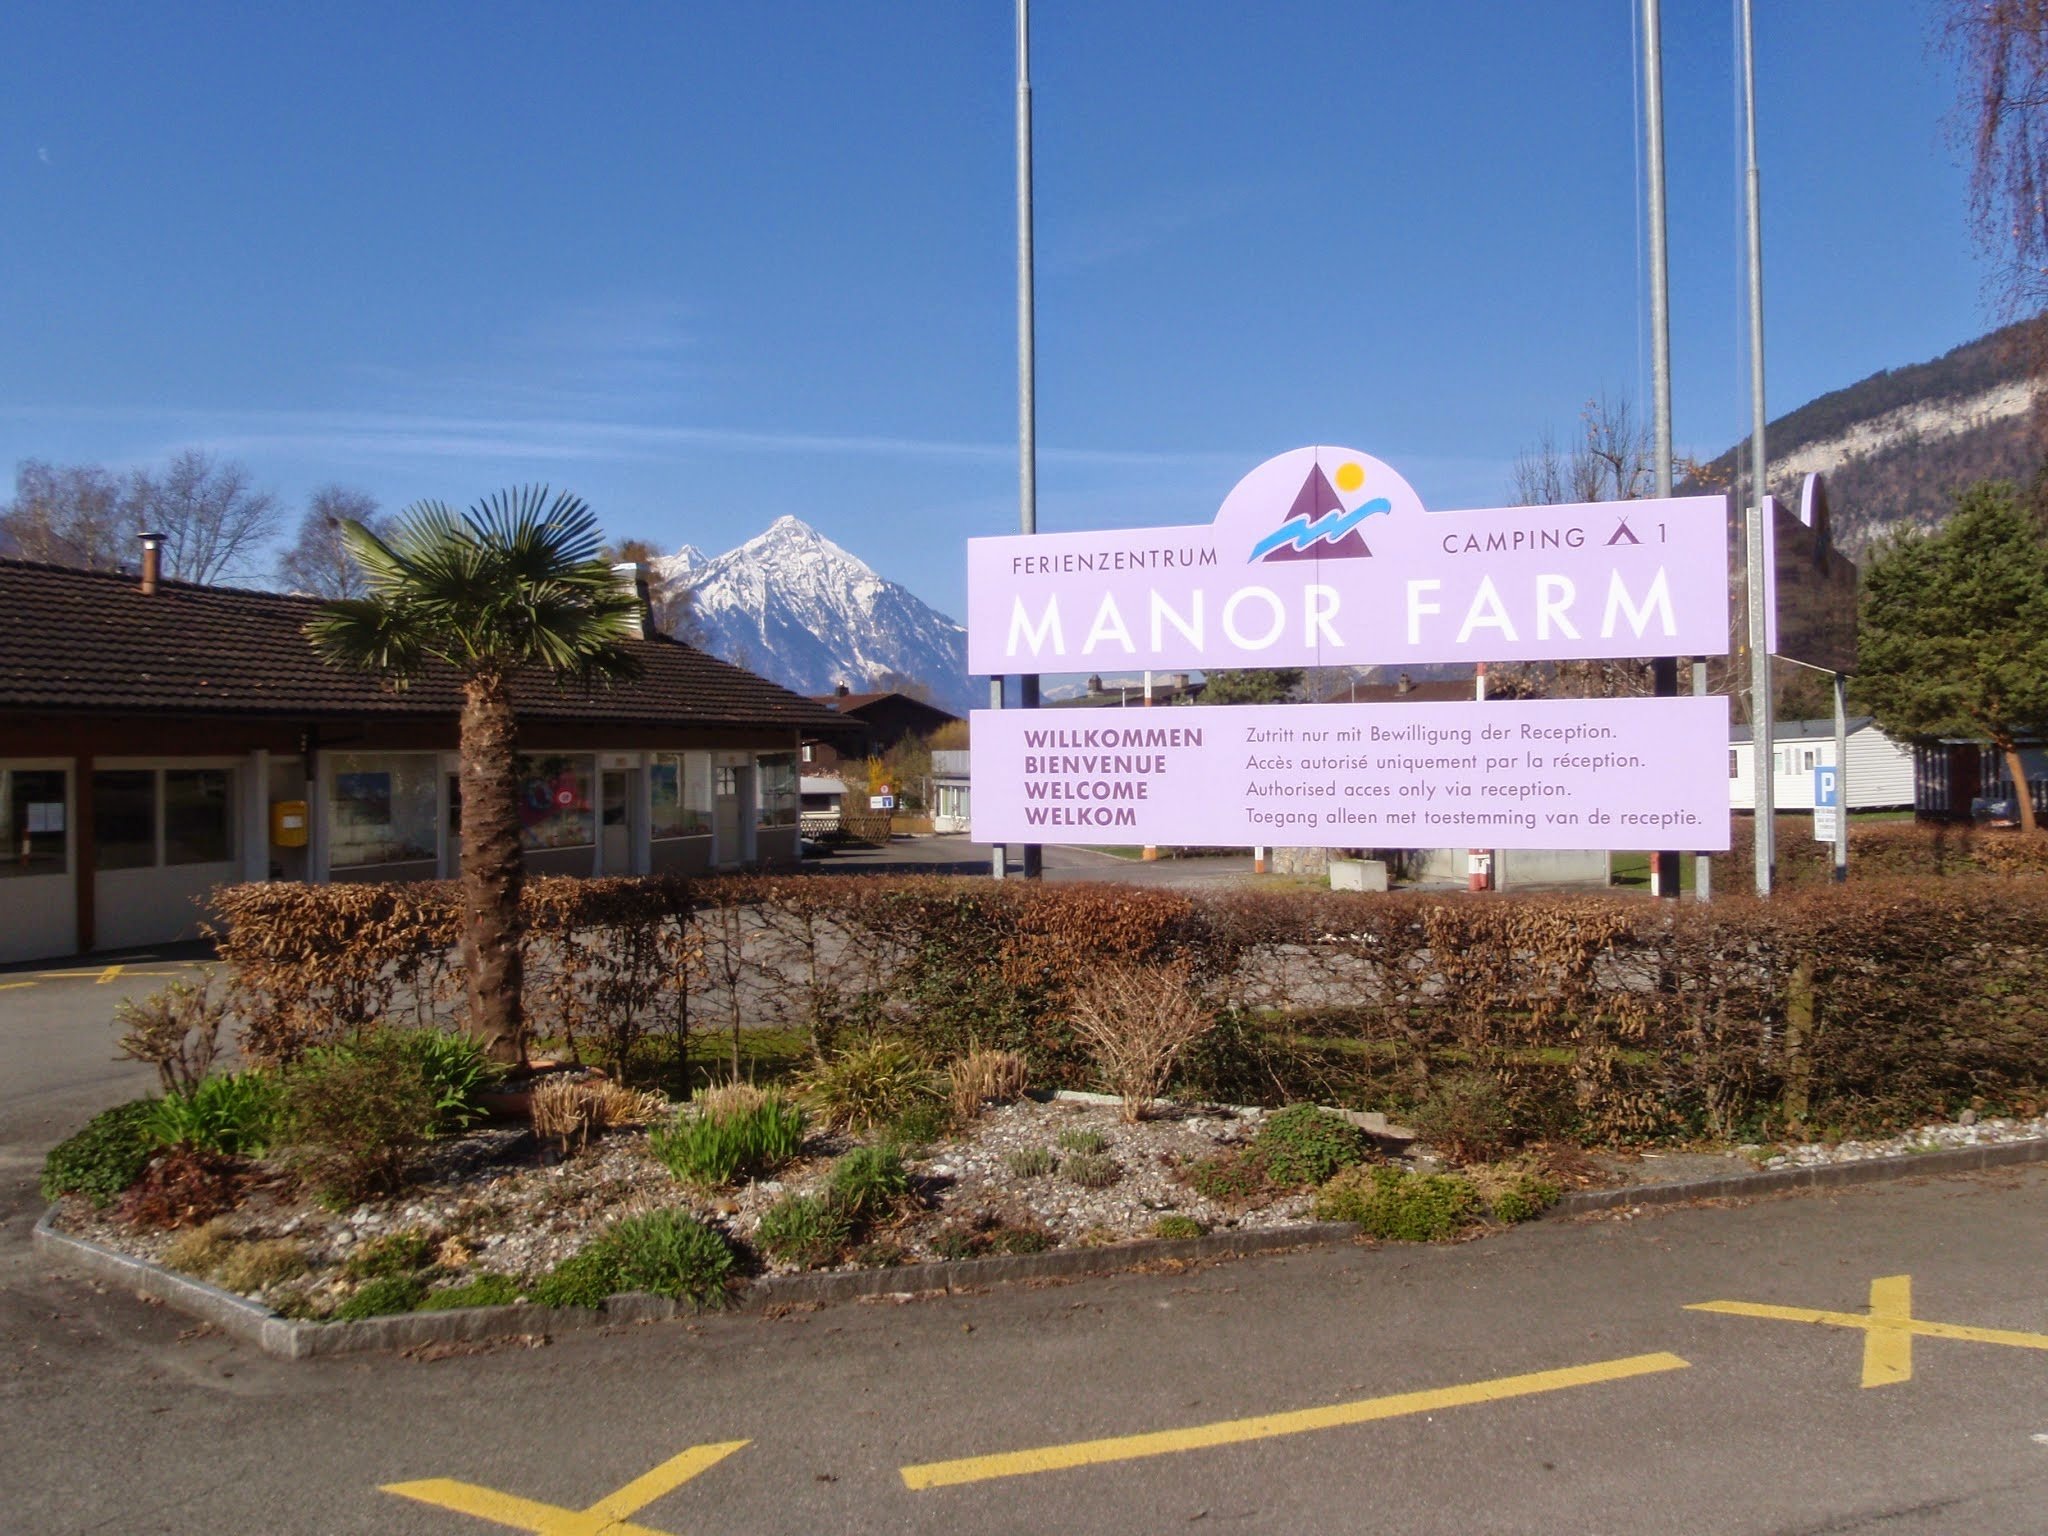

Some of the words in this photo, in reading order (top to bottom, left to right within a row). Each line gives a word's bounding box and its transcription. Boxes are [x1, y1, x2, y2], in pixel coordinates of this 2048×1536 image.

[1443, 528, 1584, 553] CAMPING
[1658, 524, 1665, 543] 1
[1013, 547, 1217, 574] FERIENZENTRUM
[1005, 583, 1345, 657] MANOR
[1406, 564, 1678, 645] FARM
[1024, 728, 1202, 748] WILLKOMMEN
[1246, 727, 1294, 742] Zutritt
[1303, 732, 1329, 742] nur
[1337, 727, 1361, 741] mit
[1371, 724, 1471, 745] Bewilligung
[1481, 723, 1511, 740] der
[1521, 723, 1616, 744] Reception.
[1025, 755, 1166, 774] BIENVENUE
[1245, 755, 1292, 769] Accès
[1301, 755, 1368, 769] autorisé
[1377, 754, 1477, 773] uniquement
[1487, 758, 1518, 773] par
[1527, 751, 1543, 768] la
[1553, 752, 1645, 772] réception.
[1024, 781, 1148, 800] WELCOME
[1246, 780, 1335, 796] Authorised
[1344, 786, 1390, 796] acces
[1399, 779, 1436, 801] only
[1445, 781, 1471, 796] via
[1481, 781, 1571, 801] reception.
[1820, 772, 1835, 803] P
[1024, 807, 1136, 826] WELKOM
[1246, 808, 1317, 828] Toegang
[1326, 807, 1377, 823] alleen
[1386, 811, 1416, 824] met
[1425, 809, 1536, 829] toestemming
[1545, 814, 1578, 824] van
[1588, 808, 1610, 824] de
[1621, 809, 1701, 829] receptie.
